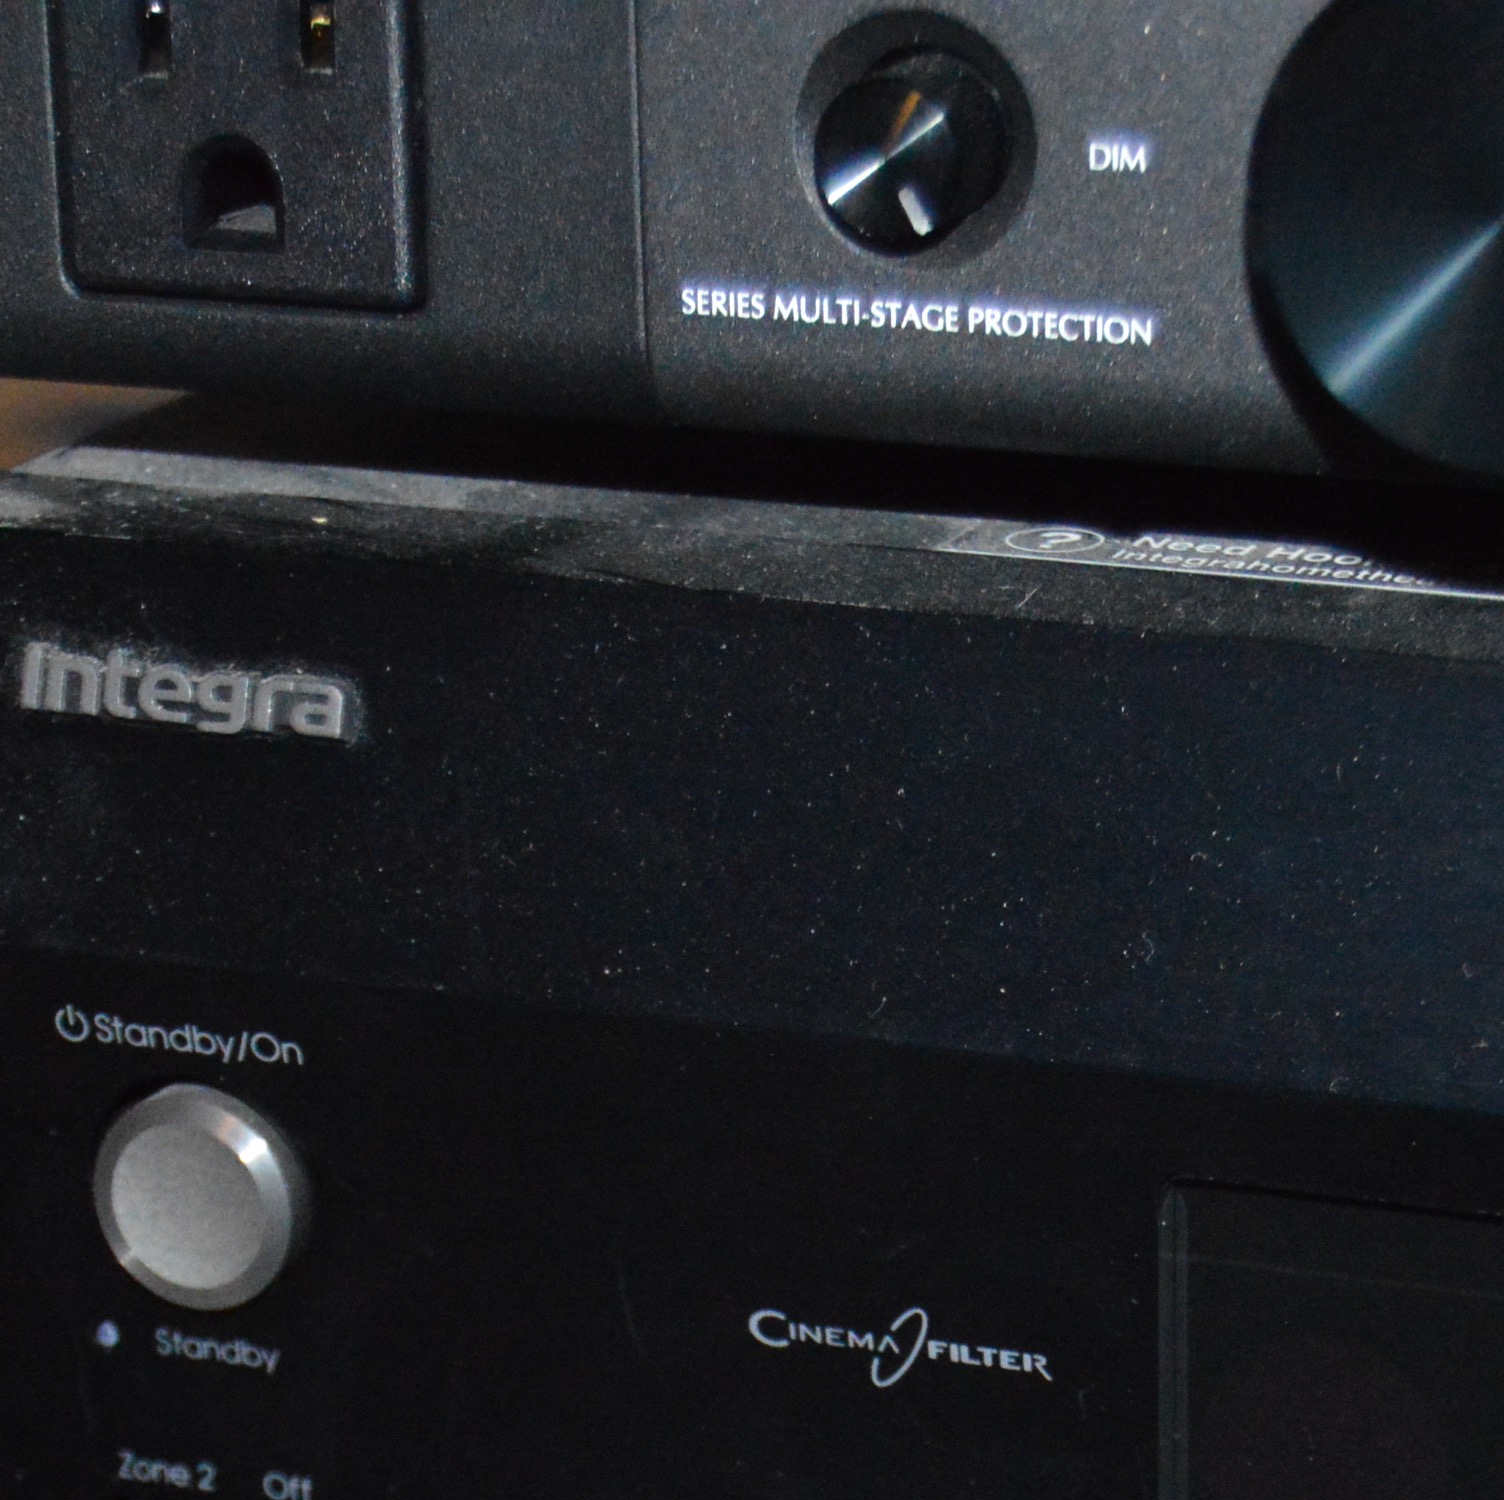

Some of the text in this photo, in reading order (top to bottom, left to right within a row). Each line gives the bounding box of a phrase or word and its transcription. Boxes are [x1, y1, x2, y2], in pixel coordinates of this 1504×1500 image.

[1090, 142, 1148, 174] DIM
[681, 288, 1153, 346] SERIES MULTI-STAGE PROTECTION
[1132, 535, 1256, 557] Need
[1266, 546, 1374, 568] Hoo
[20, 641, 344, 740] Integra
[94, 1013, 304, 1066] Standby/On
[154, 1326, 281, 1375] Standby
[927, 1340, 1053, 1382] FILTER
[118, 1449, 217, 1493] Zone 2
